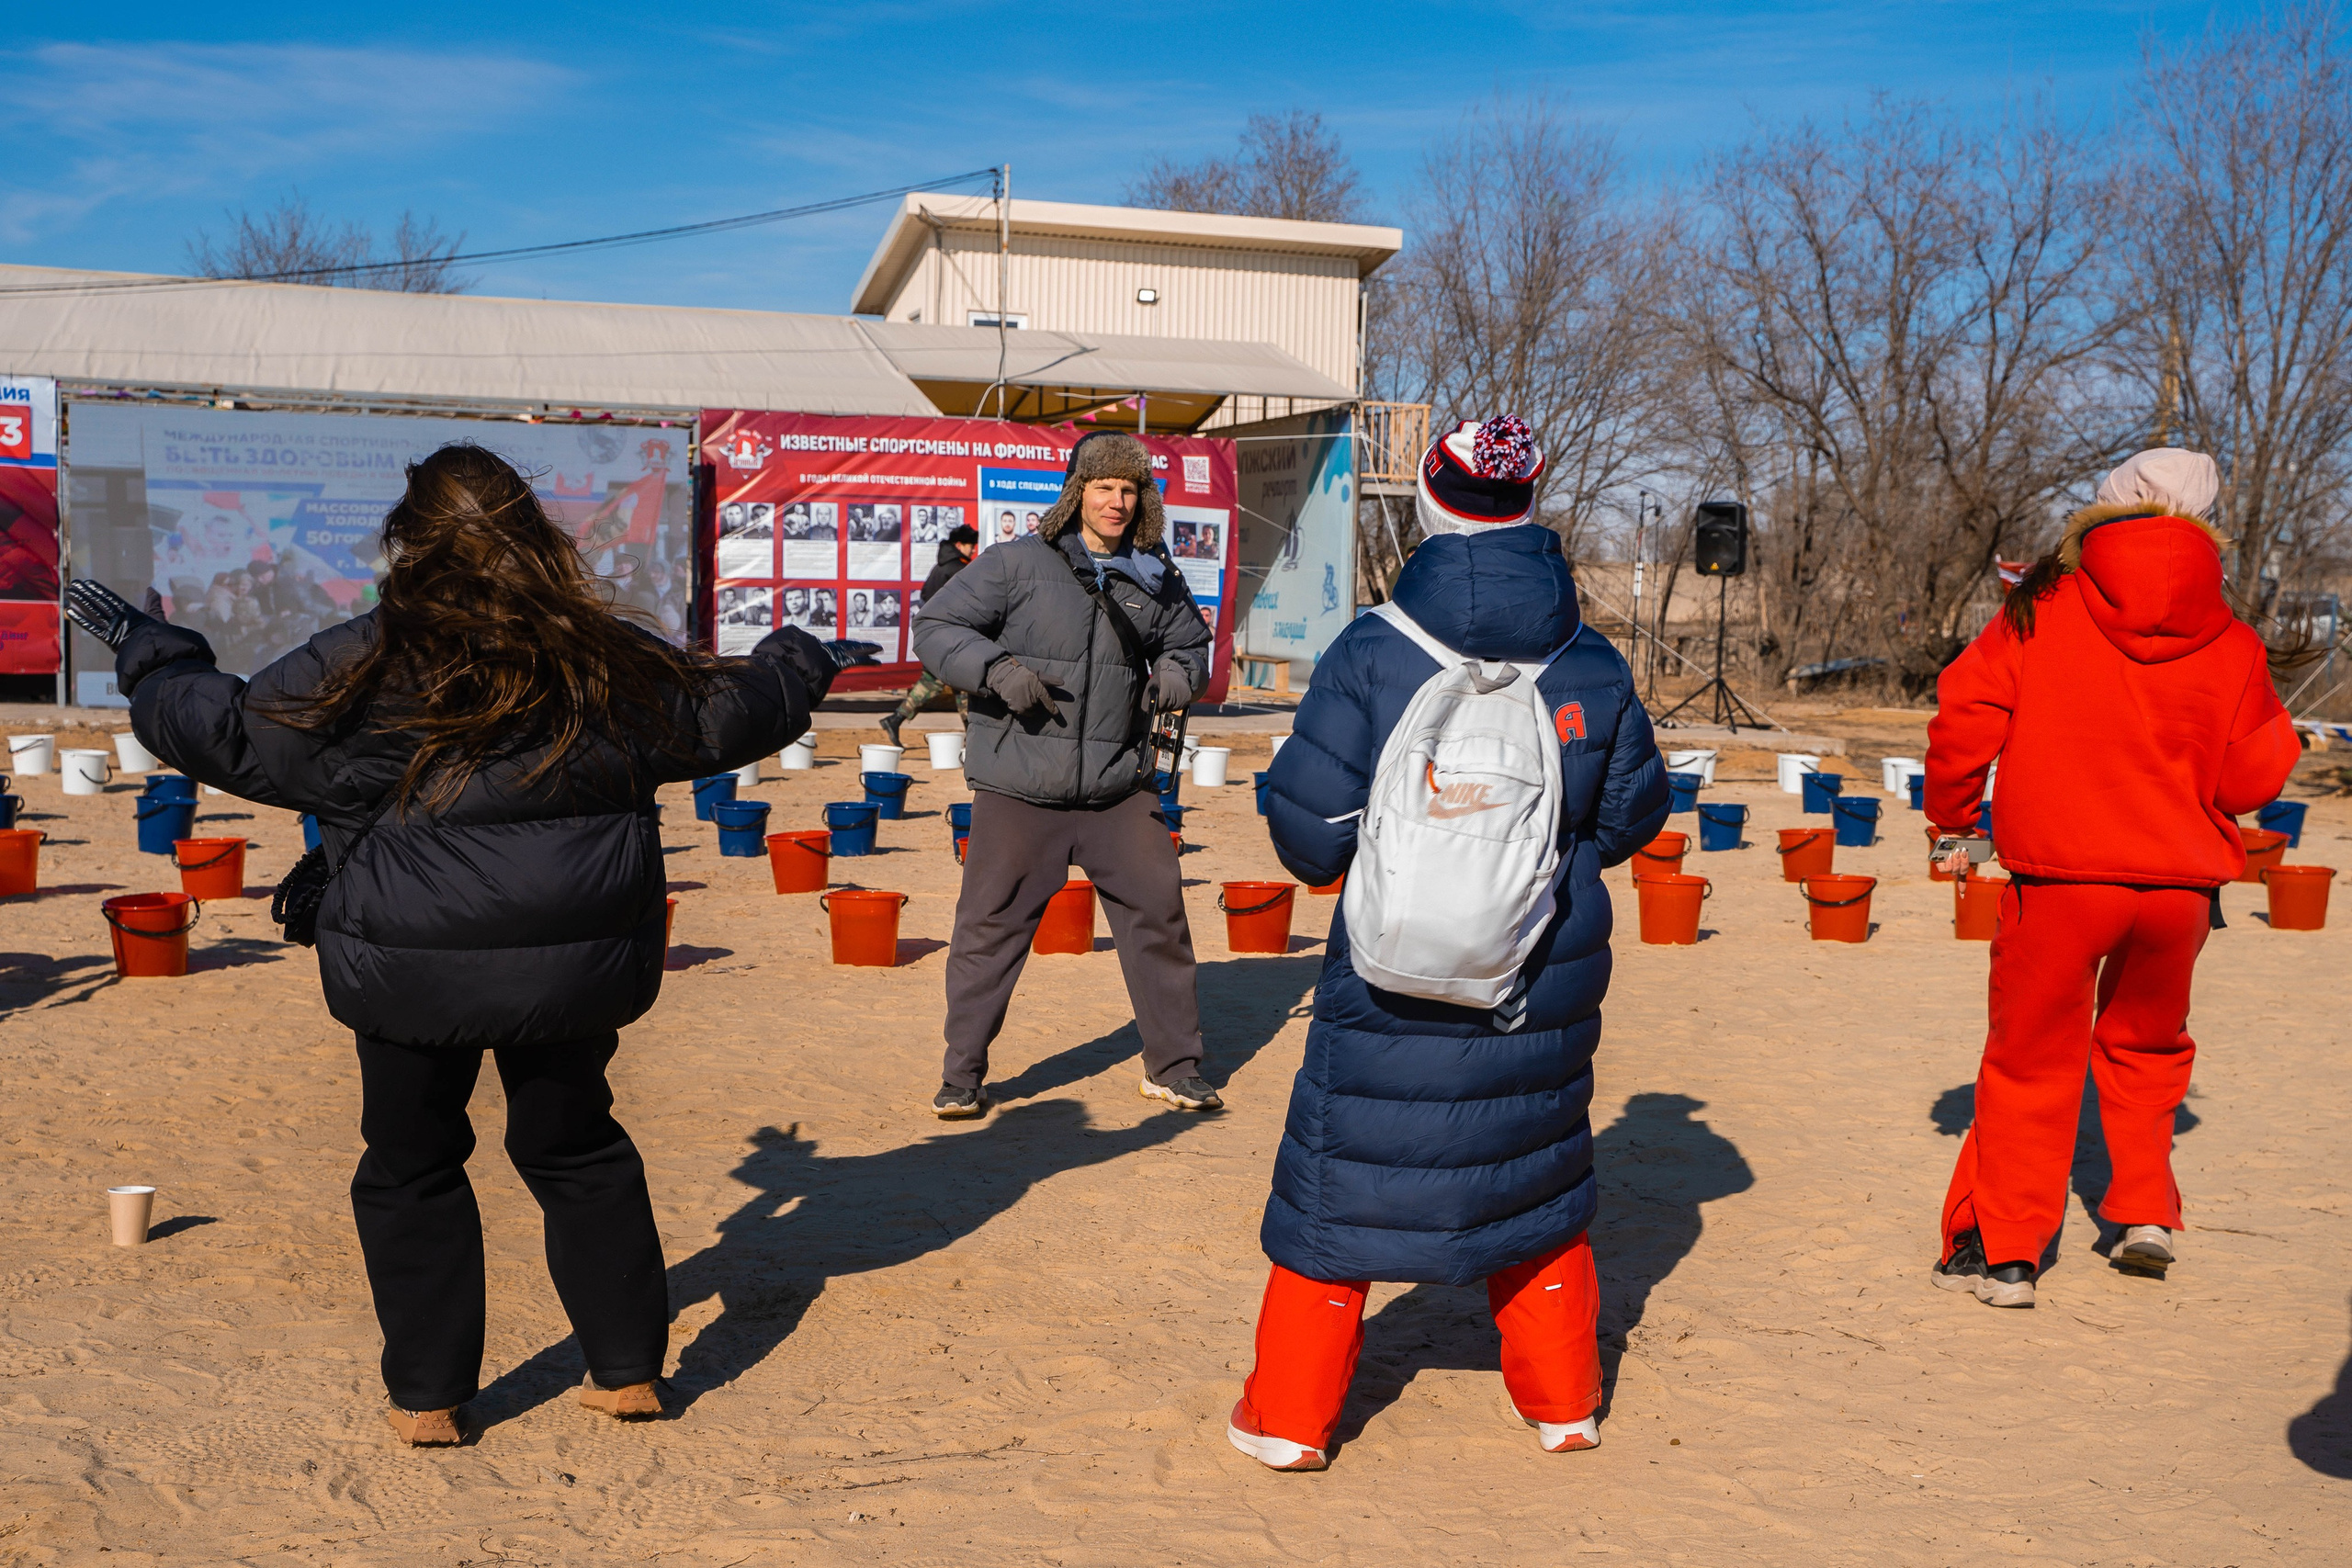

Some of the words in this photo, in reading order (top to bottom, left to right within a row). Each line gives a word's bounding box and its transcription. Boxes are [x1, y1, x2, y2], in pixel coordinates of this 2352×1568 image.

[0, 387, 30, 401] ИЯ
[246, 448, 395, 469] ЗДОРОВЫМ
[780, 434, 867, 453] ИЗВЕСТНЫЕ
[870, 437, 969, 457] СПОРТСМЕНЫ
[973, 442, 992, 457] НА
[994, 443, 1056, 461] ФРОНТЕ.
[1150, 455, 1169, 469] АС
[799, 473, 807, 483] В
[807, 474, 831, 484] ГОДЫ
[831, 472, 869, 484] ВЕЛИКОЙ
[870, 474, 936, 486] ОТЕЧЕСТВЕННОЙ
[937, 476, 967, 488] ВОЙНЫ
[989, 479, 995, 489] В
[997, 479, 1016, 491] ХОДЕ
[306, 530, 333, 546] 50
[1440, 783, 1494, 805] NIKE
